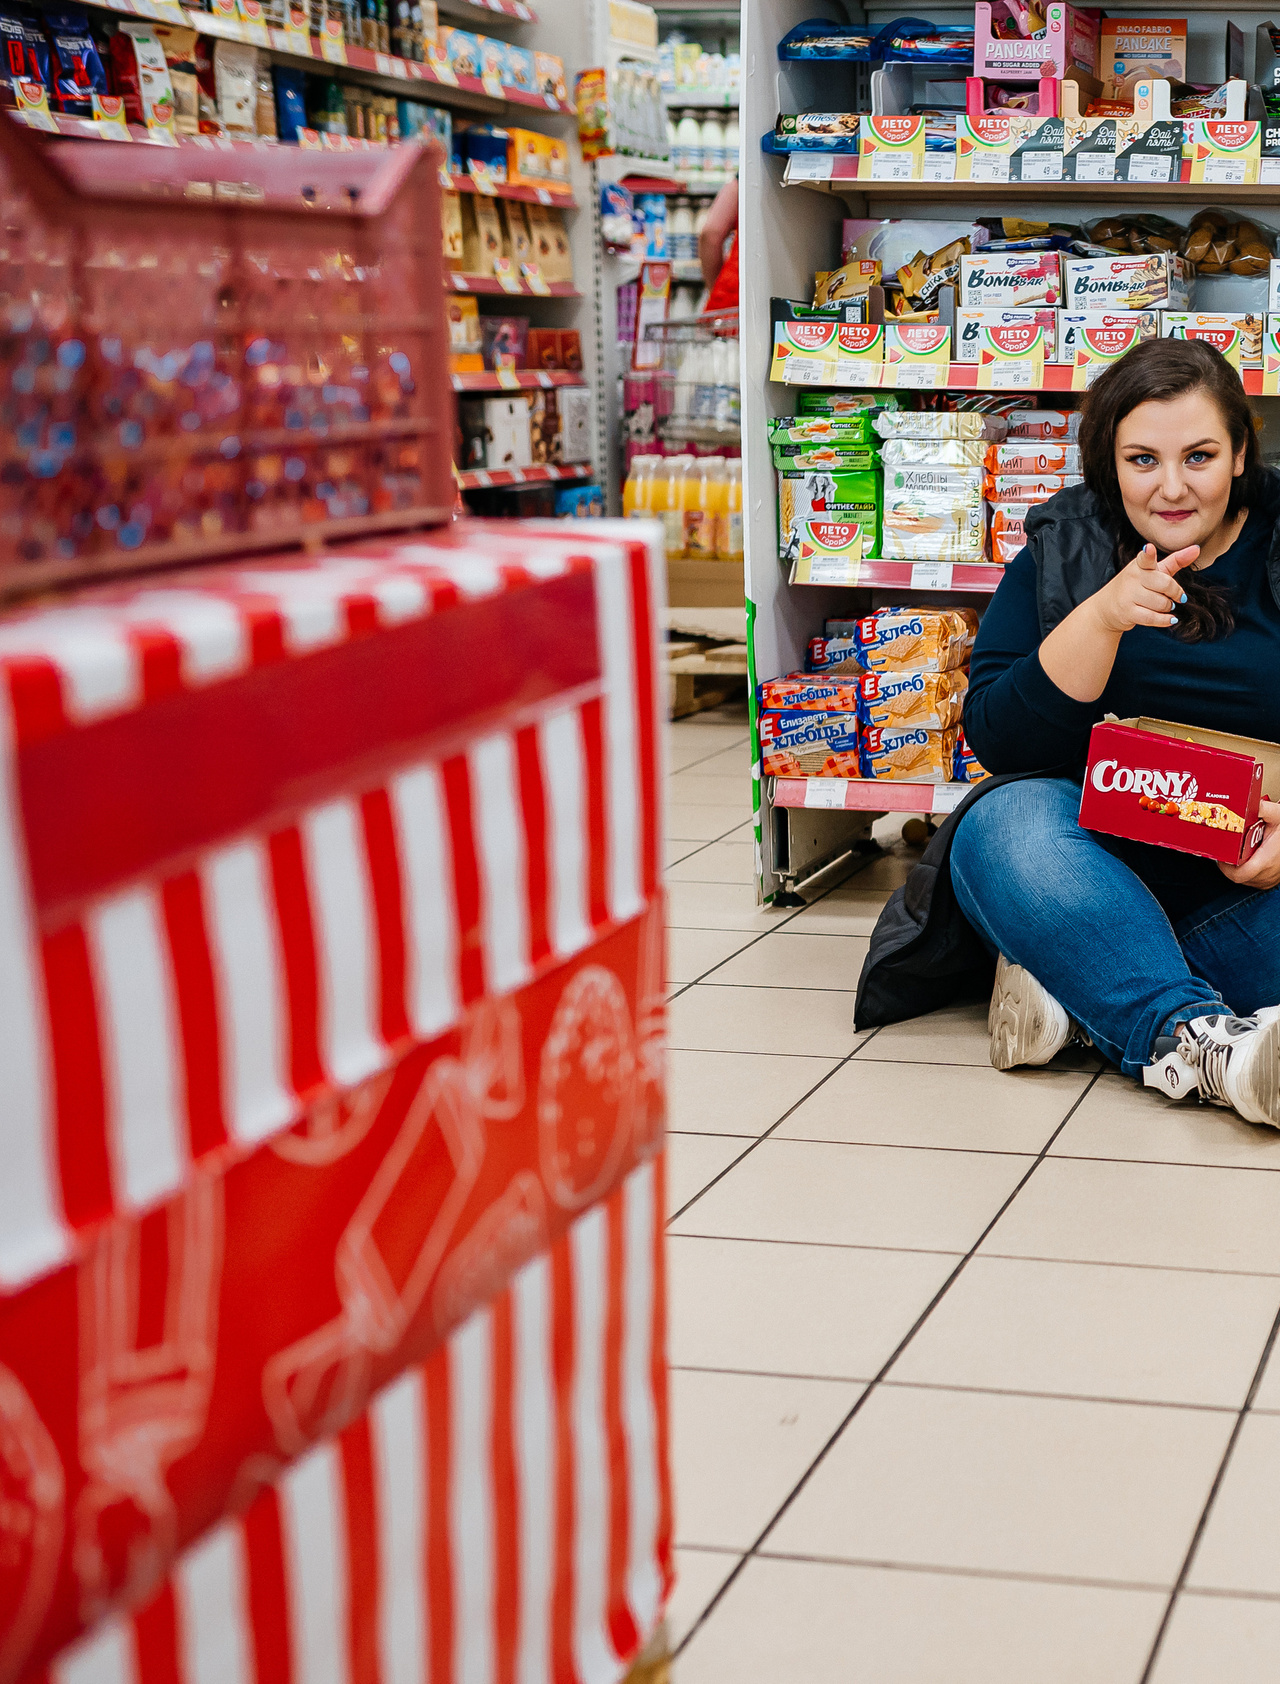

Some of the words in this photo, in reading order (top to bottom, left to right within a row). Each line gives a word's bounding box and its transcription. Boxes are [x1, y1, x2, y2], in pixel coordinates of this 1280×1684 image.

[1116, 25, 1140, 34] SNAQ
[1142, 26, 1172, 34] FABRIQ
[1114, 36, 1172, 51] PANCAKE
[985, 42, 1052, 60] PANCAKE
[880, 120, 912, 129] ЛЕТО
[978, 119, 1010, 129] ЛЕТО
[1215, 124, 1247, 134] ЛЕТО
[883, 130, 910, 141] городе
[981, 130, 1008, 141] городе
[1150, 127, 1172, 138] Дай
[1217, 136, 1245, 146] городе
[968, 269, 1044, 288] BOMBBAR
[1074, 276, 1146, 294] BOMBBAR
[796, 326, 826, 335] ЛЕТО
[840, 327, 870, 336] ЛЕТО
[906, 329, 938, 338] ЛЕТО
[999, 330, 1030, 339] ЛЕТО
[1094, 332, 1126, 340] ЛЕТО
[842, 338, 868, 348] городе
[1002, 340, 1028, 350] городе
[1097, 342, 1124, 352] городе
[906, 471, 948, 484] Хлебцы
[820, 526, 849, 535] ЛЕТО
[821, 536, 847, 546] городе
[862, 621, 872, 639] Е
[876, 618, 923, 642] хлеб
[814, 644, 822, 660] Е
[826, 647, 857, 661] хле
[864, 678, 876, 696] Е
[880, 674, 924, 698] хлеб
[782, 686, 838, 706] хлебцы
[780, 712, 828, 730] Елизавета
[760, 718, 774, 741] Е
[771, 722, 847, 750] хлебцы
[869, 730, 879, 746] Е
[881, 729, 928, 750] хлеб
[1092, 759, 1190, 799] CORNY
